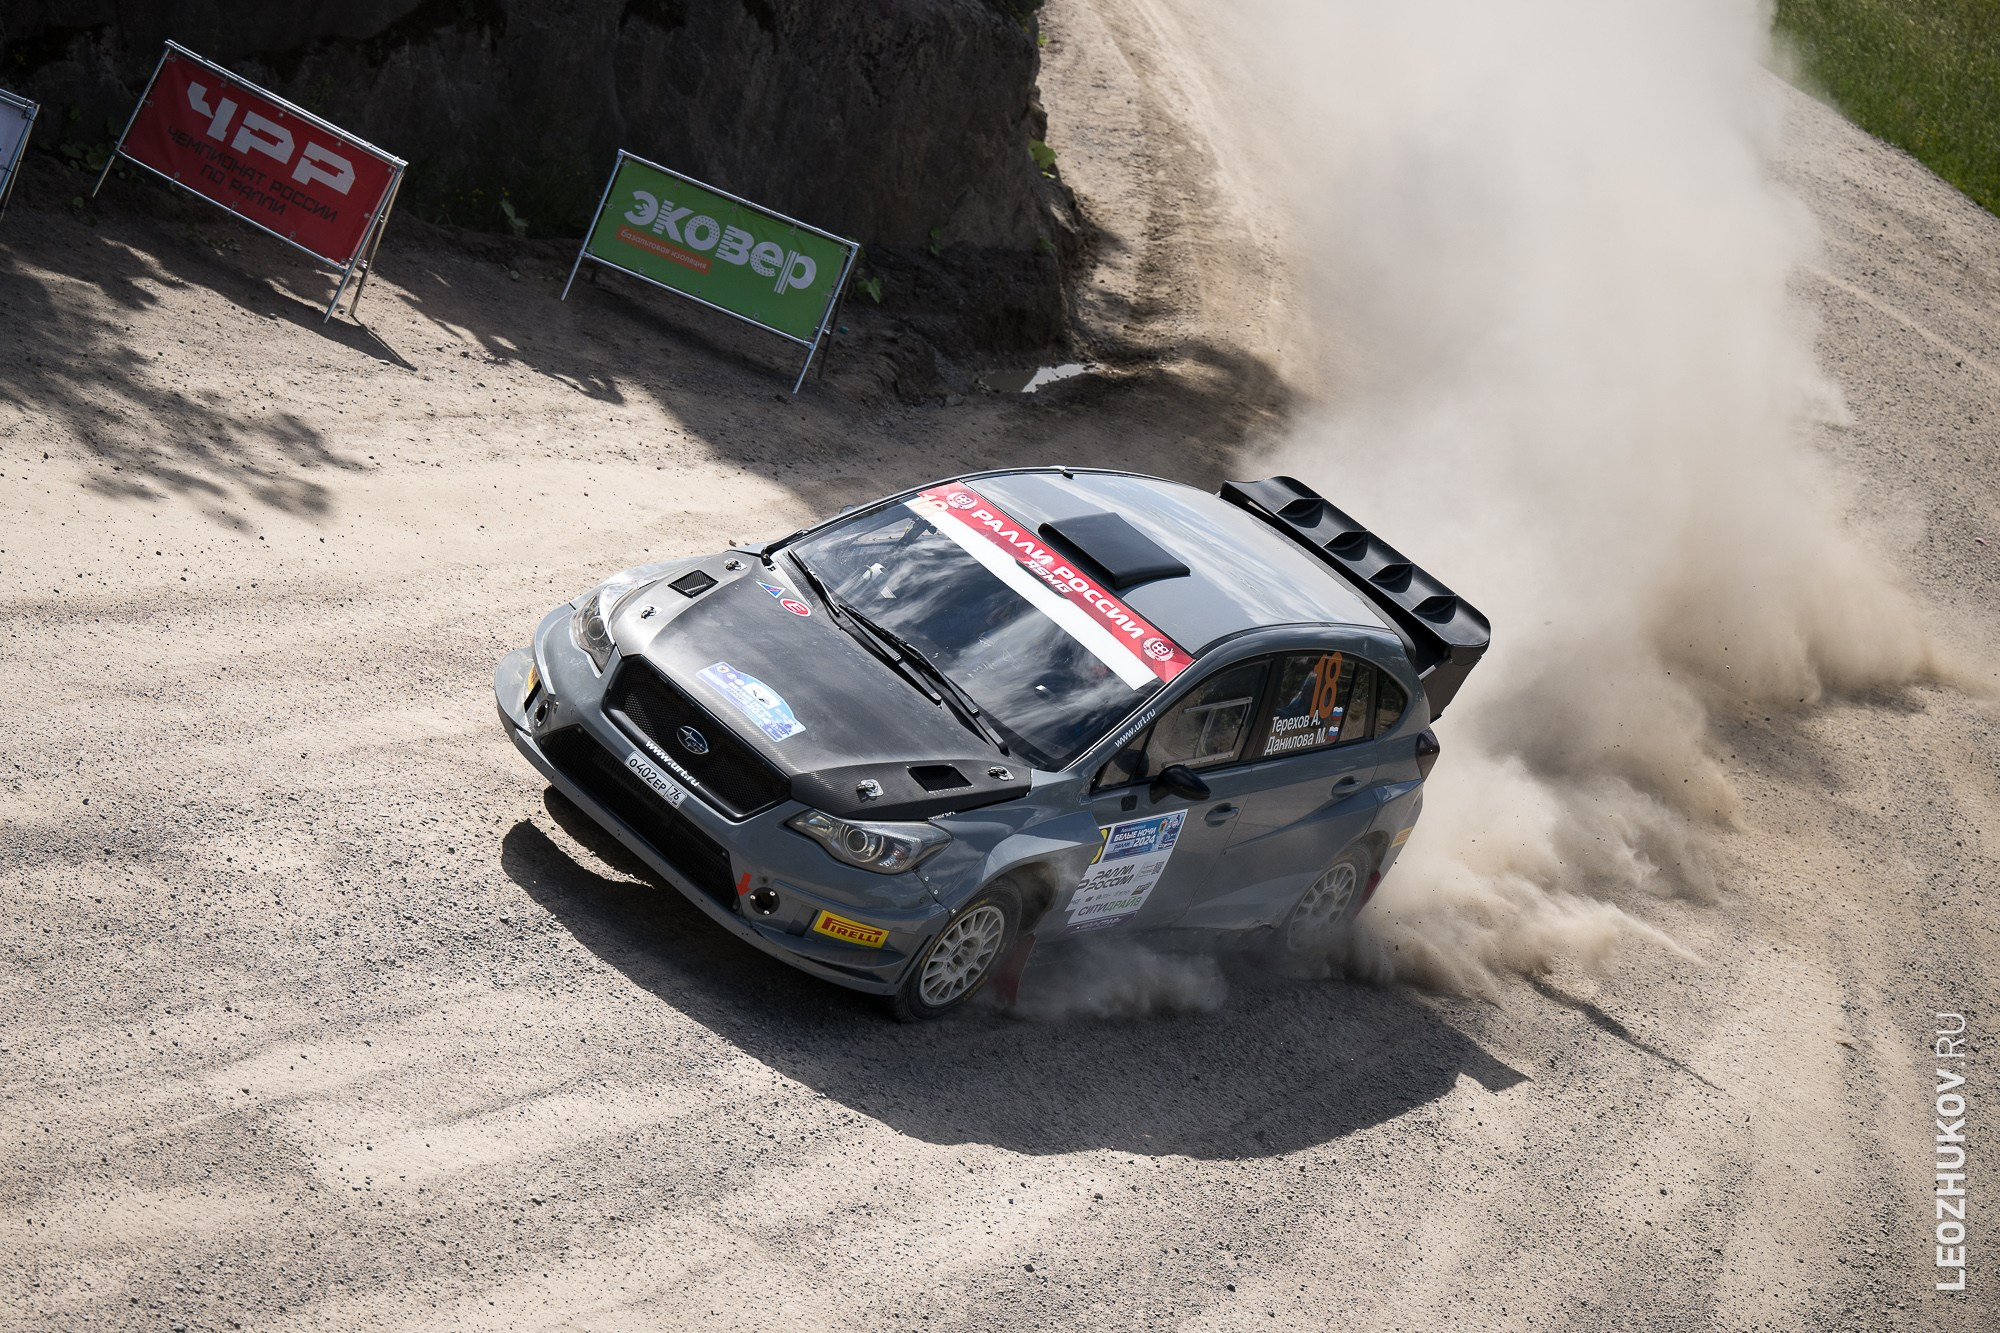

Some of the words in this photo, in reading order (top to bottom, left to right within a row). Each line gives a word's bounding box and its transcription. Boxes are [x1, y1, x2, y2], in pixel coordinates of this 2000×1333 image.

[187, 81, 356, 195] ЧРР
[167, 126, 267, 185] ЧЕМПИОНАТ
[269, 180, 338, 223] РОССИИ
[200, 164, 225, 185] ПО
[228, 179, 287, 216] РАЛЛИ
[621, 229, 670, 254] базальтовая
[671, 251, 707, 269] изоляция
[970, 509, 1053, 566] РАЛЛИ
[1052, 565, 1144, 640] РОССИИ
[1309, 652, 1342, 719] 18
[1114, 709, 1156, 747] www.urt.ru
[1263, 732, 1313, 756] Данилова
[1315, 727, 1326, 744] М.
[1271, 715, 1310, 736] Терехов
[1311, 709, 1321, 726] А.
[629, 759, 667, 791] О402ЕР
[669, 788, 681, 800] 76
[645, 741, 700, 787] www.urt.ru
[1114, 830, 1138, 842] БЕЛЫЕ
[1137, 827, 1156, 838] НОЧИ
[1133, 835, 1156, 848] 2024
[1084, 874, 1134, 892] РОССИИ
[1092, 864, 1135, 881] РАЛЛИ
[1078, 896, 1142, 916] СИТИДРАЙВ
[821, 916, 883, 943] PIRELLI
